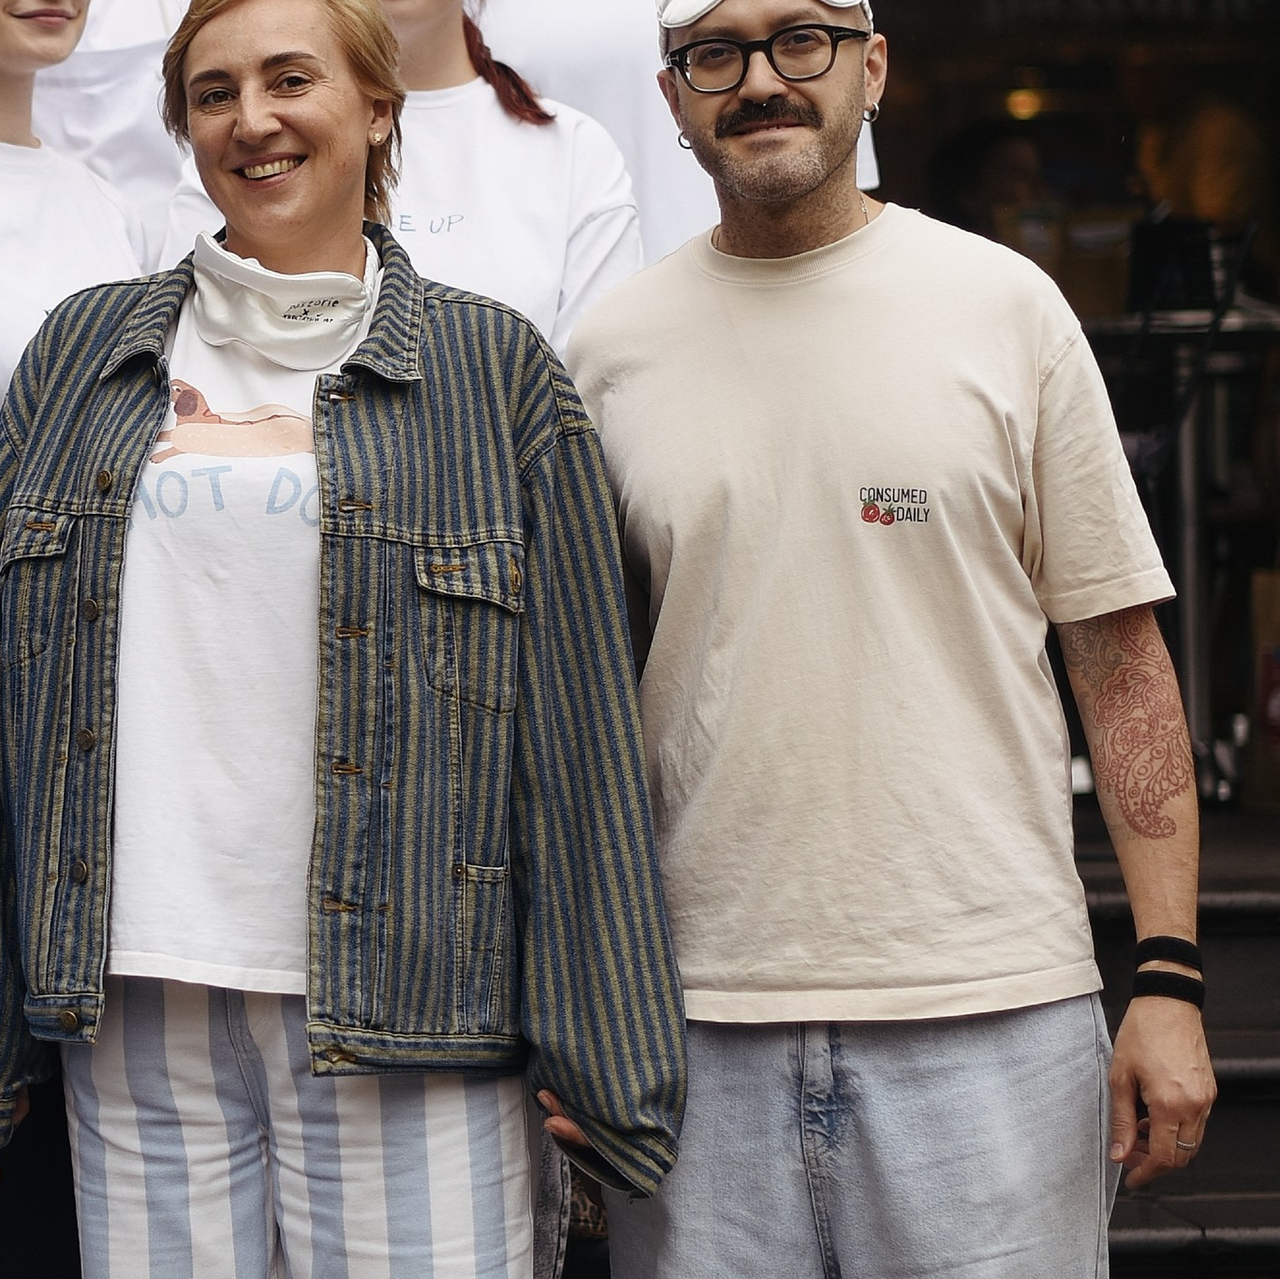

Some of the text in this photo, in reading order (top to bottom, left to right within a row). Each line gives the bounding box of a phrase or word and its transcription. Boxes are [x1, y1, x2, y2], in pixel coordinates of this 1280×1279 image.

[429, 214, 464, 234] UP
[859, 486, 928, 505] CONSUMED
[896, 506, 931, 523] DAILY
